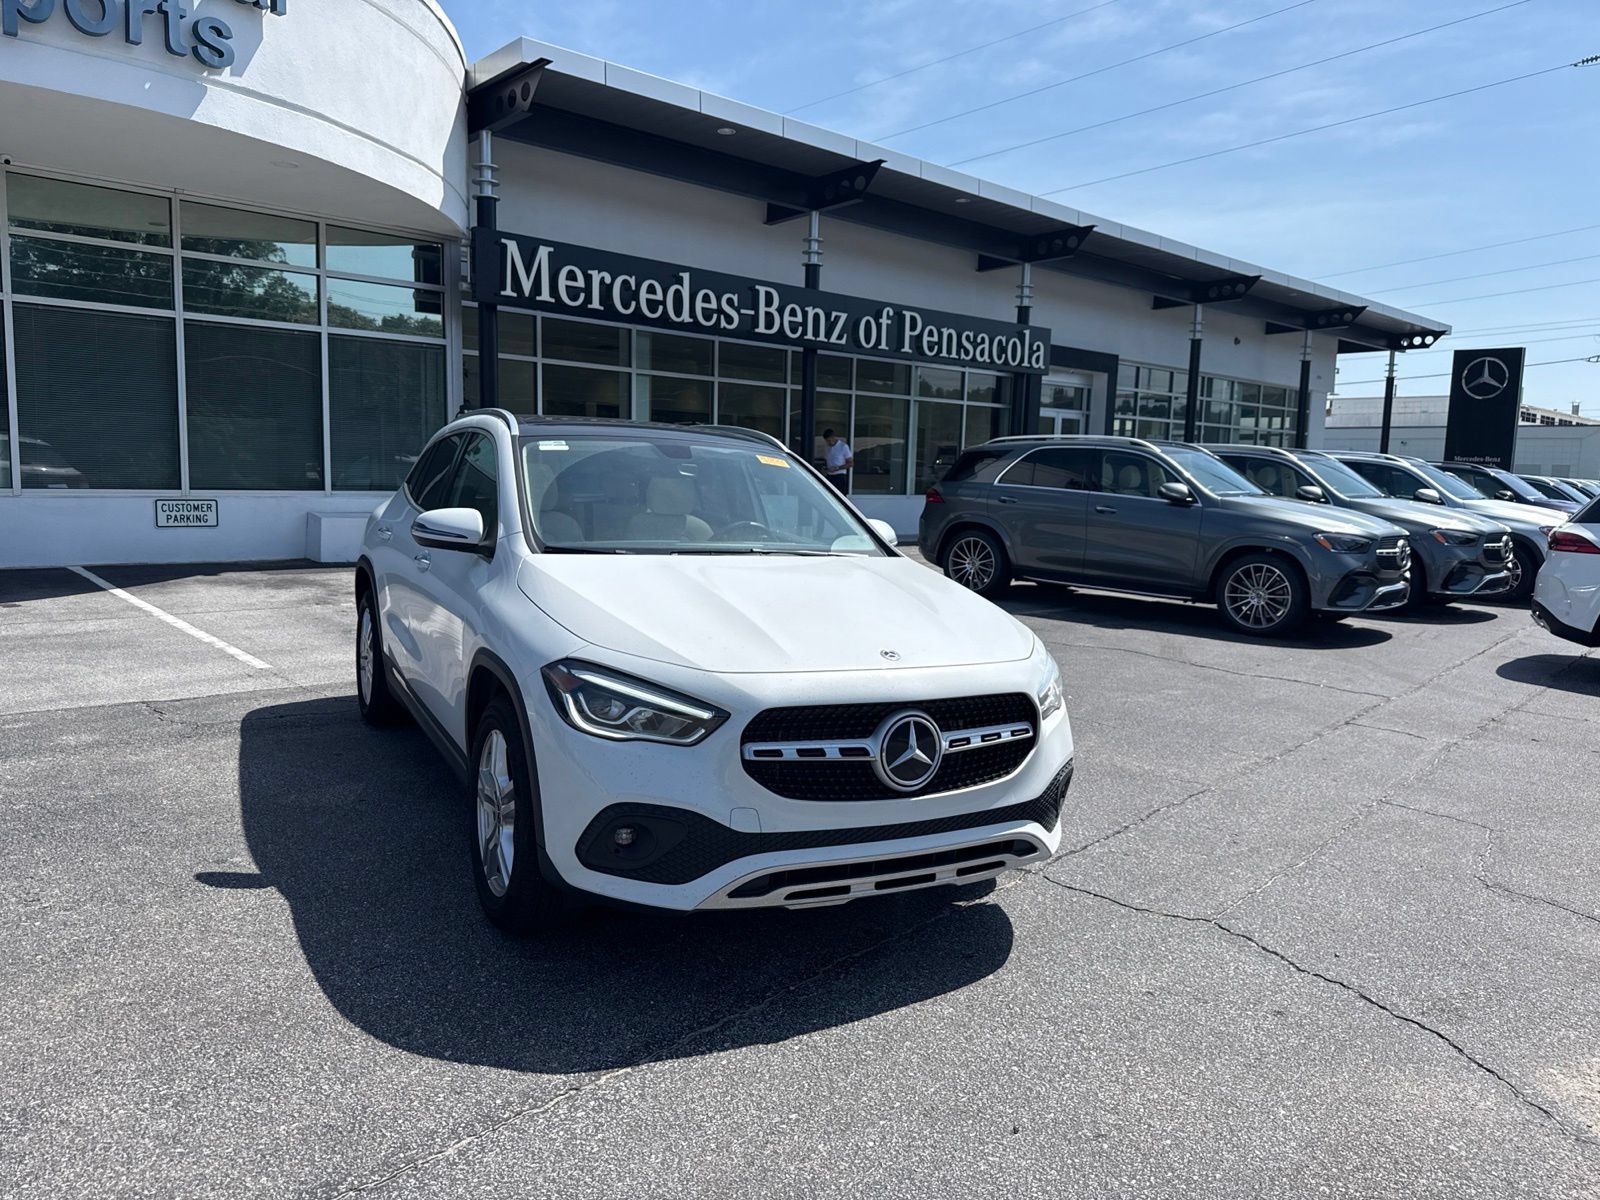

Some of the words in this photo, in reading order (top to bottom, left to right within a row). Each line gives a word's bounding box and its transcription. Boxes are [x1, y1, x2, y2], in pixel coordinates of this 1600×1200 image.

[500, 238, 849, 344] Mercedes-Benz
[858, 306, 894, 350] of
[900, 310, 1046, 369] Pensacola
[161, 503, 213, 513] CUSTOMER
[166, 514, 209, 524] PARKING
